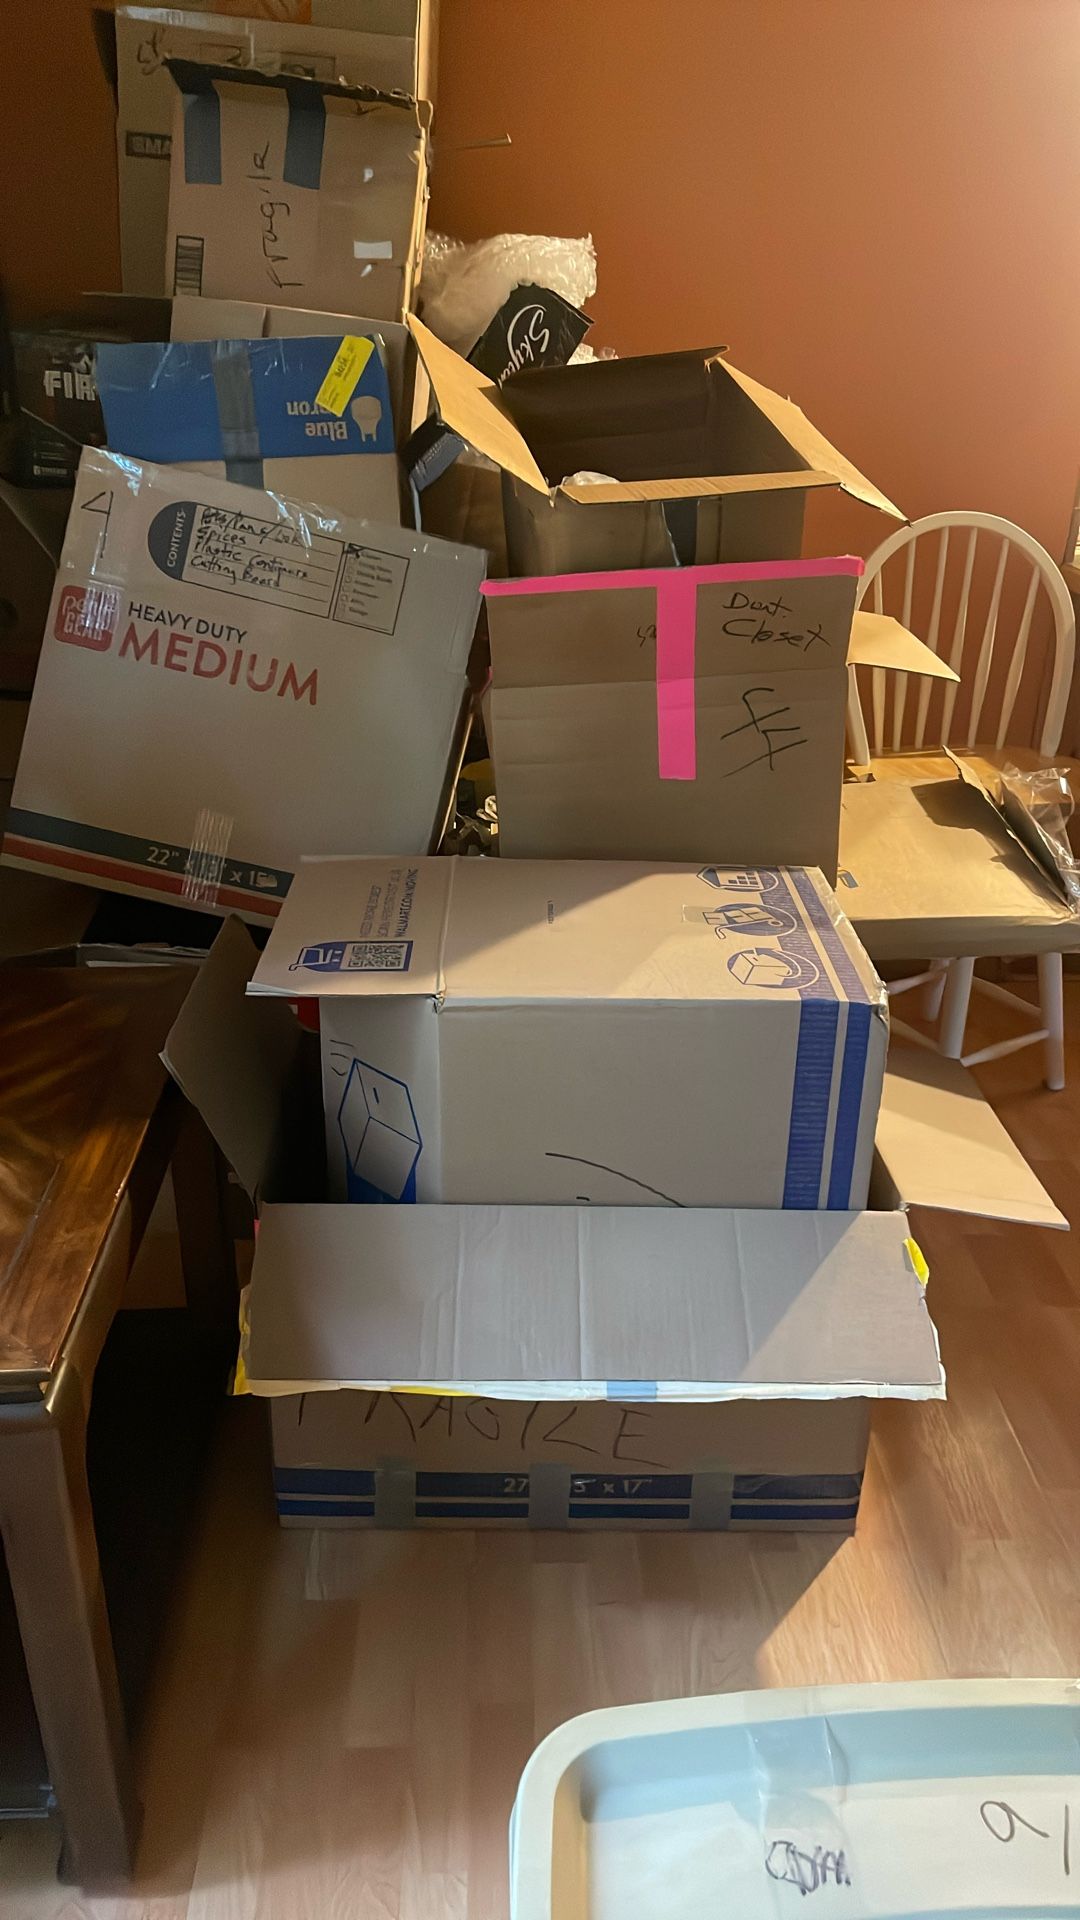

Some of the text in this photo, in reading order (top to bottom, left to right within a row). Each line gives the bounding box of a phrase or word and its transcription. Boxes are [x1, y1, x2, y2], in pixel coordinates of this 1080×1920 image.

[44, 370, 96, 401] FIR
[286, 401, 332, 416] ron
[305, 421, 348, 442] Blue
[196, 525, 247, 546] Spices
[190, 555, 236, 586] Cutting
[128, 601, 248, 644] HEAVY DUTY
[118, 622, 318, 706] MEDIUM
